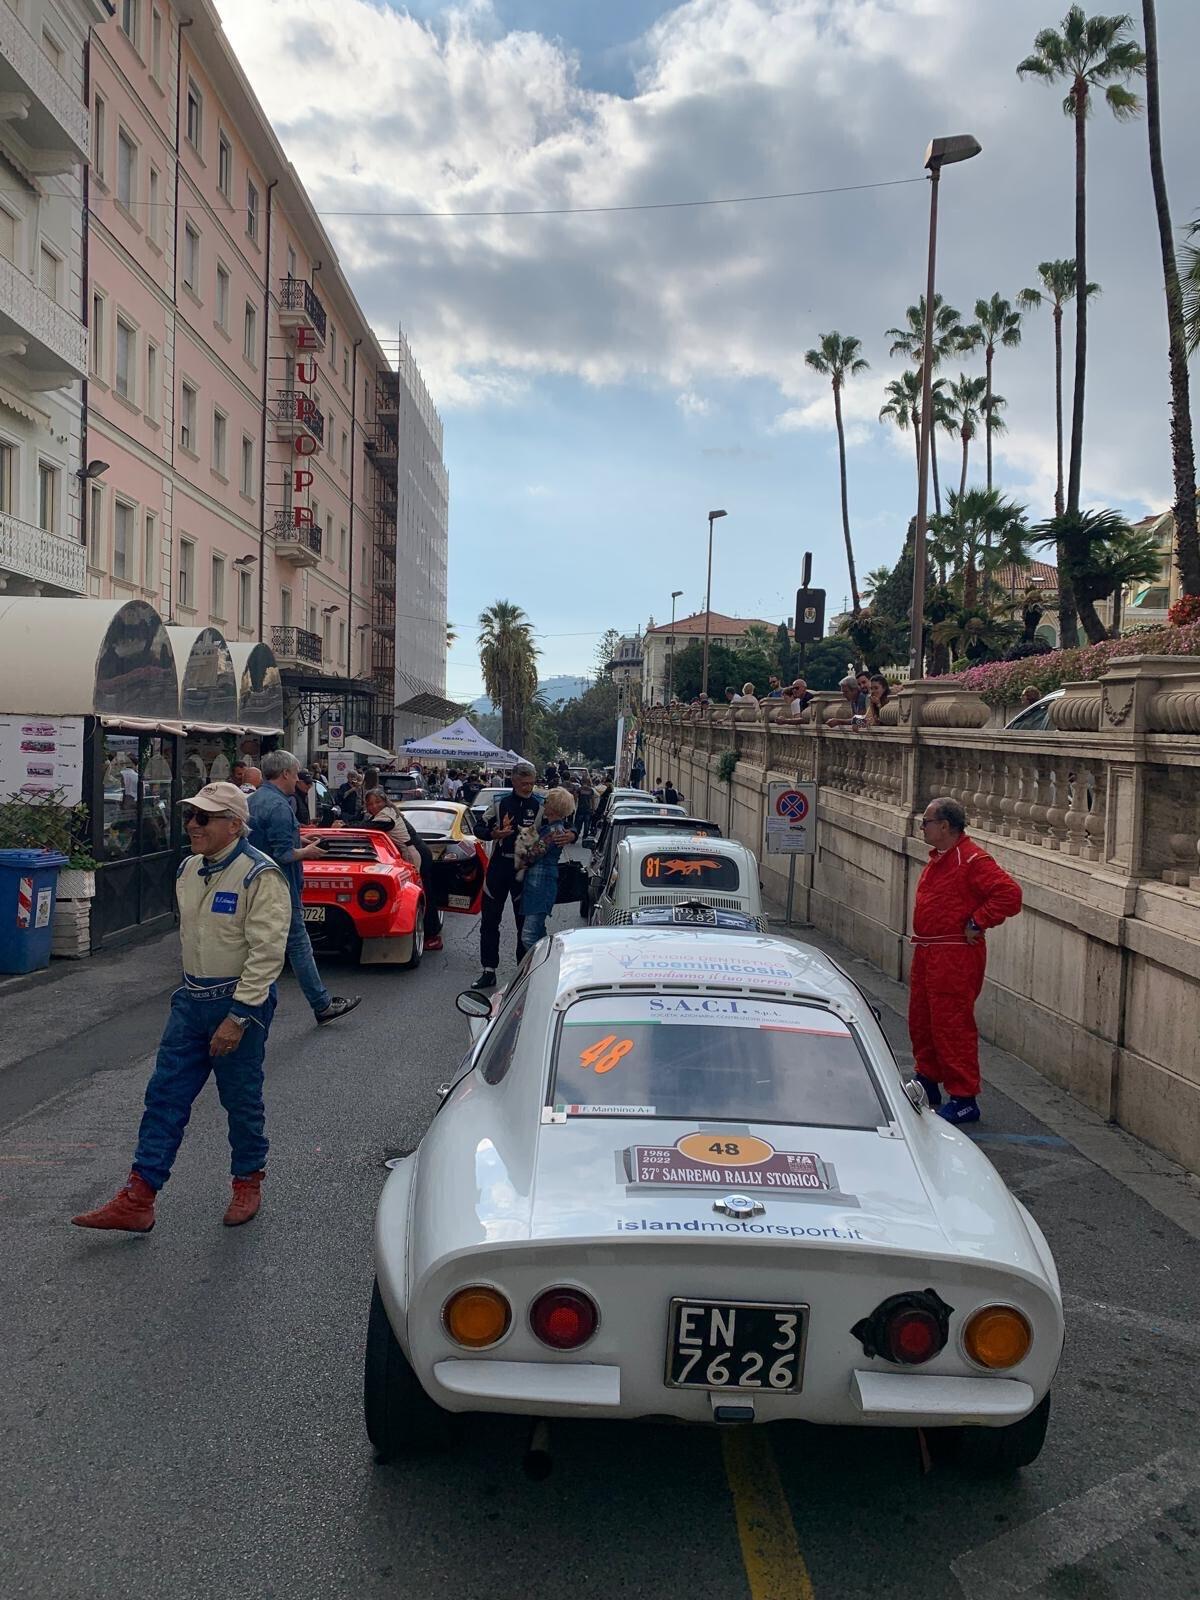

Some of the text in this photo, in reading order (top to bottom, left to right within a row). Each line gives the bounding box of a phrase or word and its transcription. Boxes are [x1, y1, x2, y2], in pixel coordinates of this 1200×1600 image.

[293, 326, 319, 529] EUROPA
[405, 747, 440, 755] Automobile
[480, 750, 499, 758] Ligure
[646, 857, 660, 878] 81
[303, 881, 354, 889] IRELLI
[642, 960, 789, 977] noeminicosia
[579, 1034, 635, 1074] 48
[708, 1142, 740, 1156] 48
[642, 1156, 671, 1164] 2022
[662, 1167, 721, 1183] SANREMO
[724, 1170, 763, 1184] RALLY
[766, 1172, 820, 1187] STORICO
[616, 1219, 863, 1241] islandmotorsport.it
[679, 1307, 798, 1350] EN 3
[677, 1348, 795, 1388] 7626
